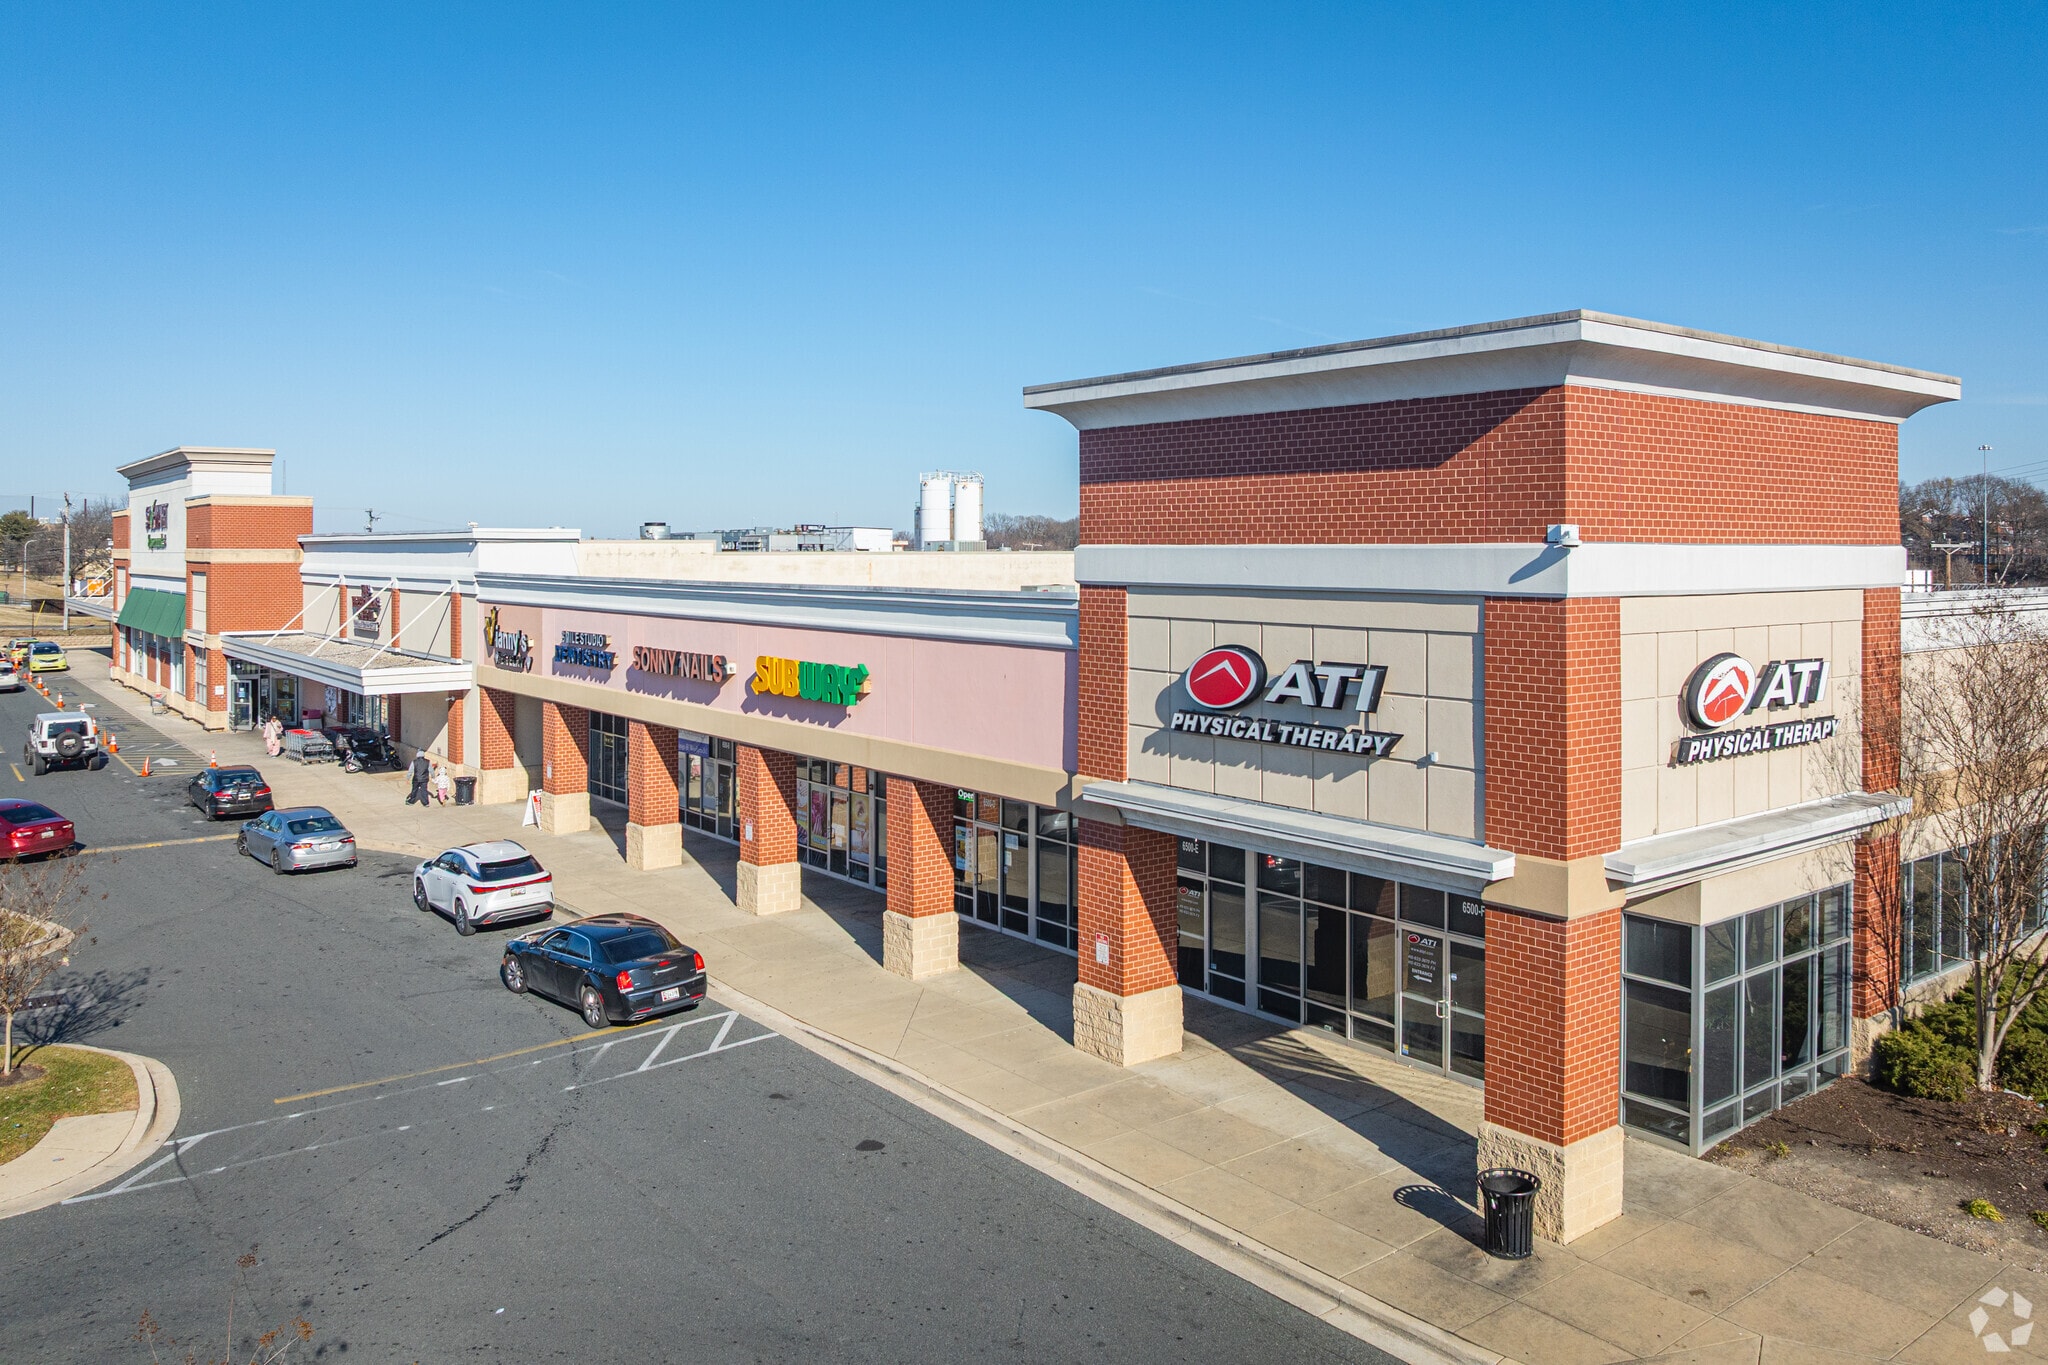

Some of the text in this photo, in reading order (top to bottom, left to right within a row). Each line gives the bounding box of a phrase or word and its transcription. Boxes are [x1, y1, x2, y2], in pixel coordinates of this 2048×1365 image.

[485, 607, 528, 656] Vianny's
[555, 645, 614, 669] DENTISTRY
[633, 646, 725, 682] SONNY NAILS
[751, 656, 868, 706] SUBWAY
[1264, 662, 1379, 713] ATI
[1759, 661, 1831, 708] ATI
[1171, 712, 1391, 756] PHYSICAL THERAPY
[1688, 719, 1841, 762] PHYSICAL THERAPY
[1462, 901, 1485, 917] 6500-F
[1420, 938, 1437, 947] ATI
